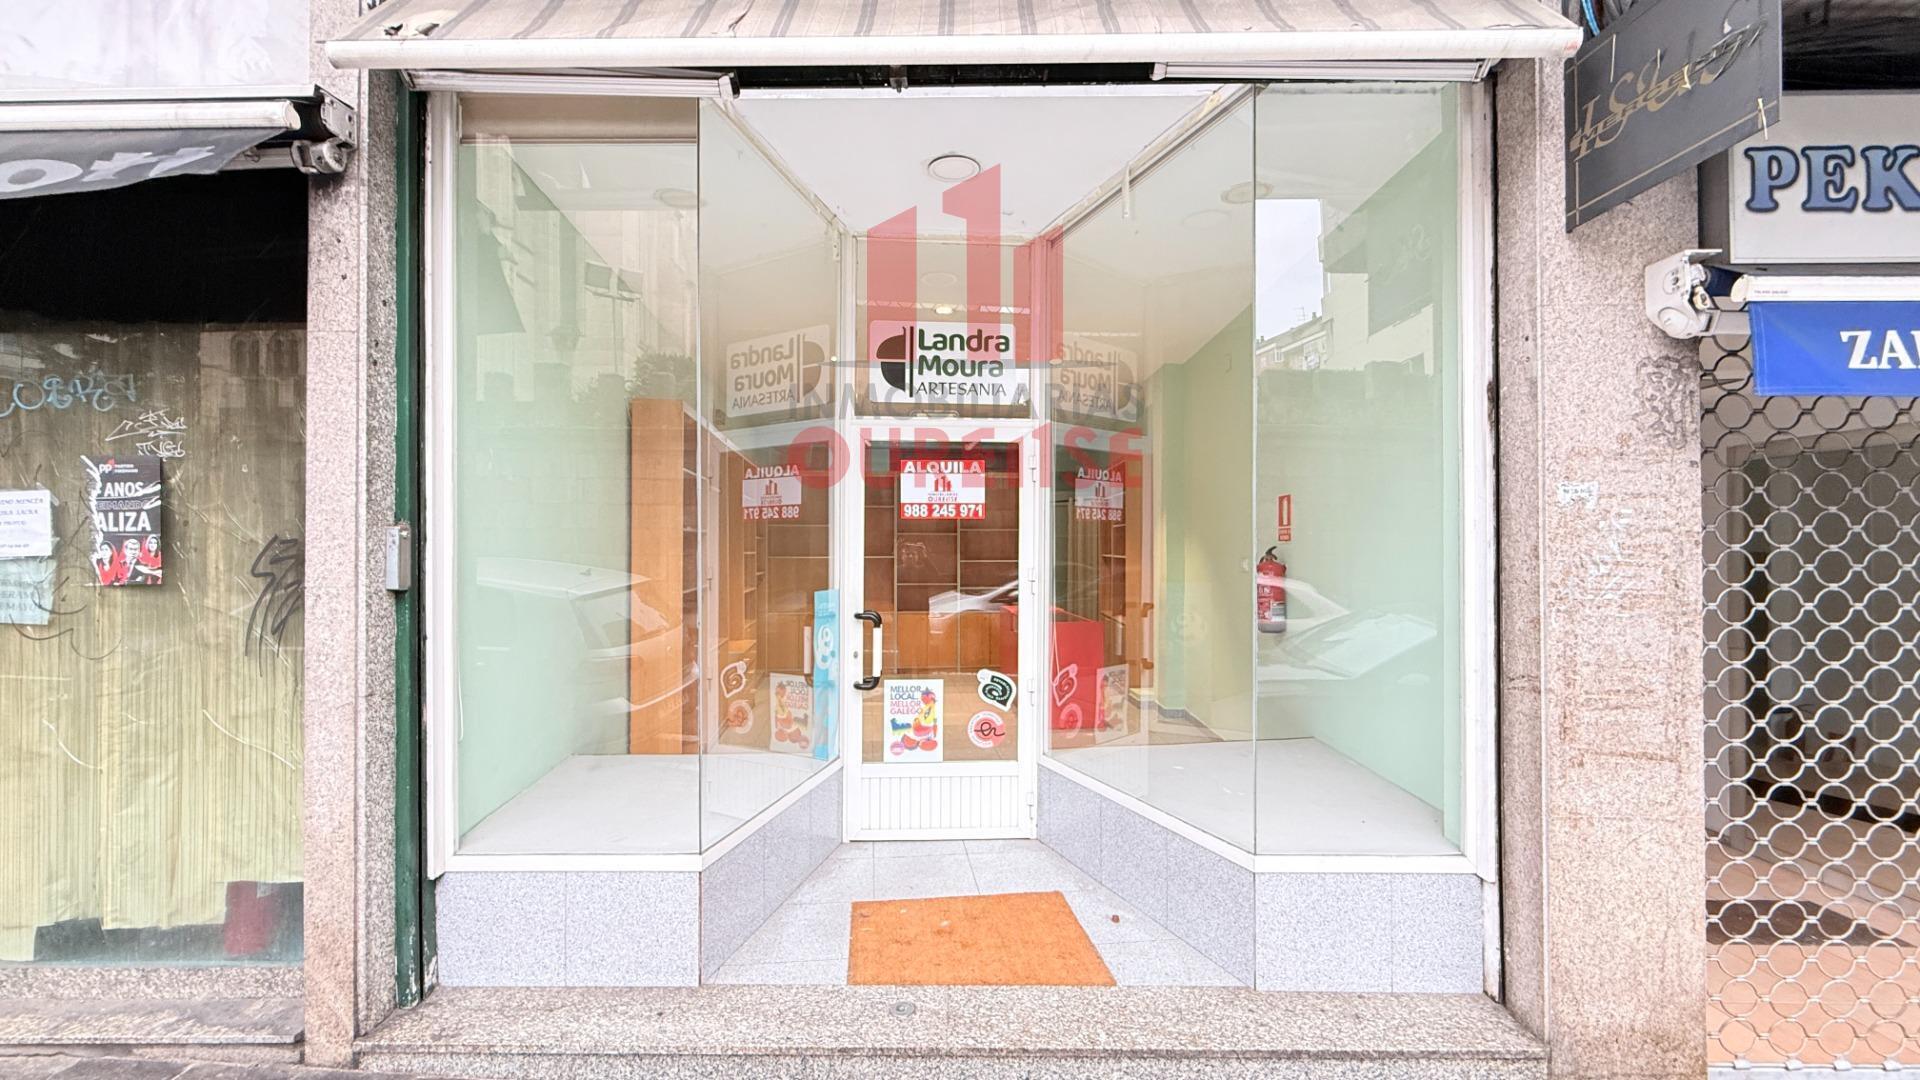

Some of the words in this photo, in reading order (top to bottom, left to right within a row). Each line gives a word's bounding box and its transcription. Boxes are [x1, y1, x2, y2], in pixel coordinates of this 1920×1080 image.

[918, 328, 1010, 352] Landra
[918, 355, 1003, 377] Moura
[916, 382, 1007, 396] ARTESANIA
[903, 461, 983, 474] ALQUILA
[103, 481, 144, 498] ANOS
[904, 504, 929, 518] 988
[931, 504, 956, 518] 245
[960, 504, 983, 518] 971
[97, 511, 152, 532] ALIZA
[890, 700, 922, 708] MELLOR
